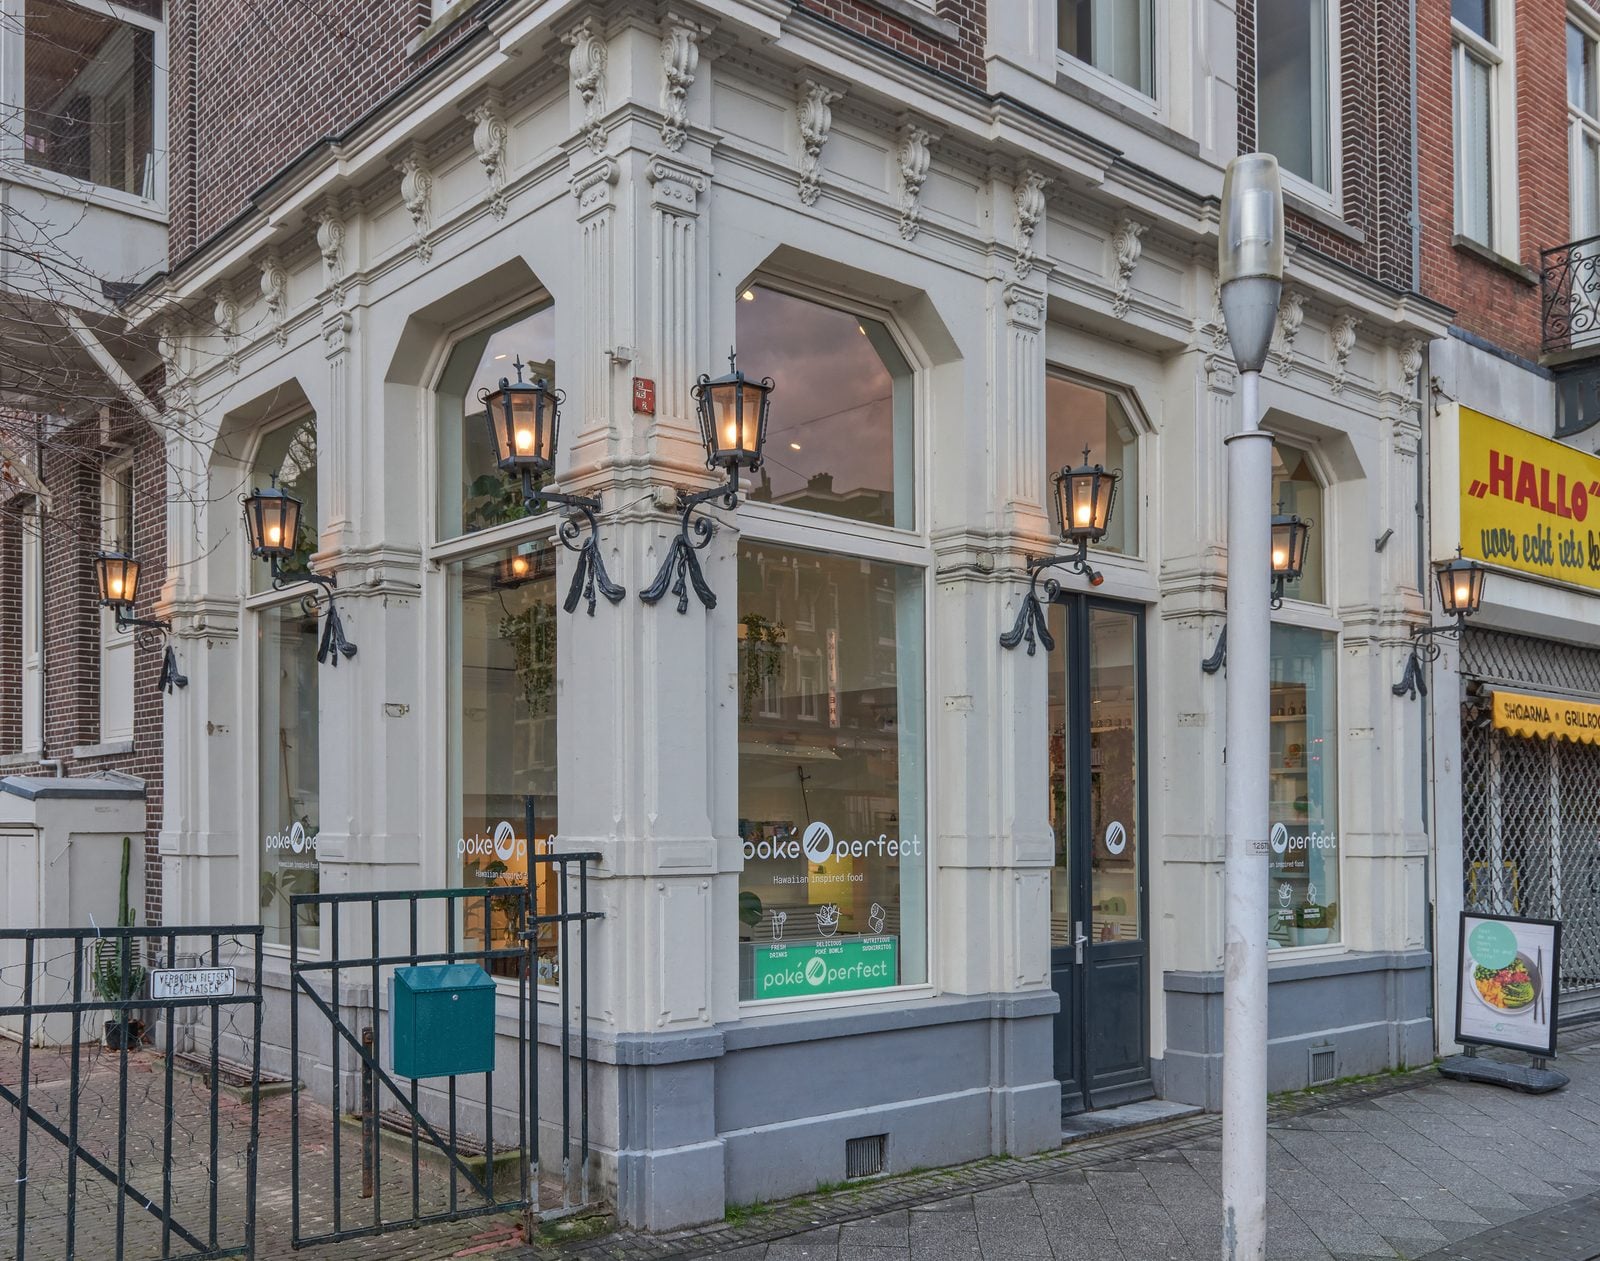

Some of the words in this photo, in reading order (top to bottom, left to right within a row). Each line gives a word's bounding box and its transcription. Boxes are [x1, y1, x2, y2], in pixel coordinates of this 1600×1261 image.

[1481, 527, 1518, 561] voor
[1523, 523, 1554, 566] echt
[1558, 529, 1584, 568] iets
[1588, 529, 1600, 571] le
[1503, 702, 1552, 724] SHOARMA
[265, 825, 290, 853] poké
[457, 826, 493, 859] poké
[836, 834, 922, 863] perfect
[1288, 830, 1337, 853] perfect
[773, 876, 808, 885] Hawaiian
[811, 874, 844, 884] inspired
[847, 873, 863, 882] food
[769, 951, 788, 959] DRINKS
[160, 974, 197, 983] VERBODEN
[201, 973, 229, 981] FIETSEN
[763, 962, 804, 990] poké
[828, 960, 887, 984] perfect
[168, 986, 177, 994] TE
[180, 984, 219, 994] PLAATSEN
